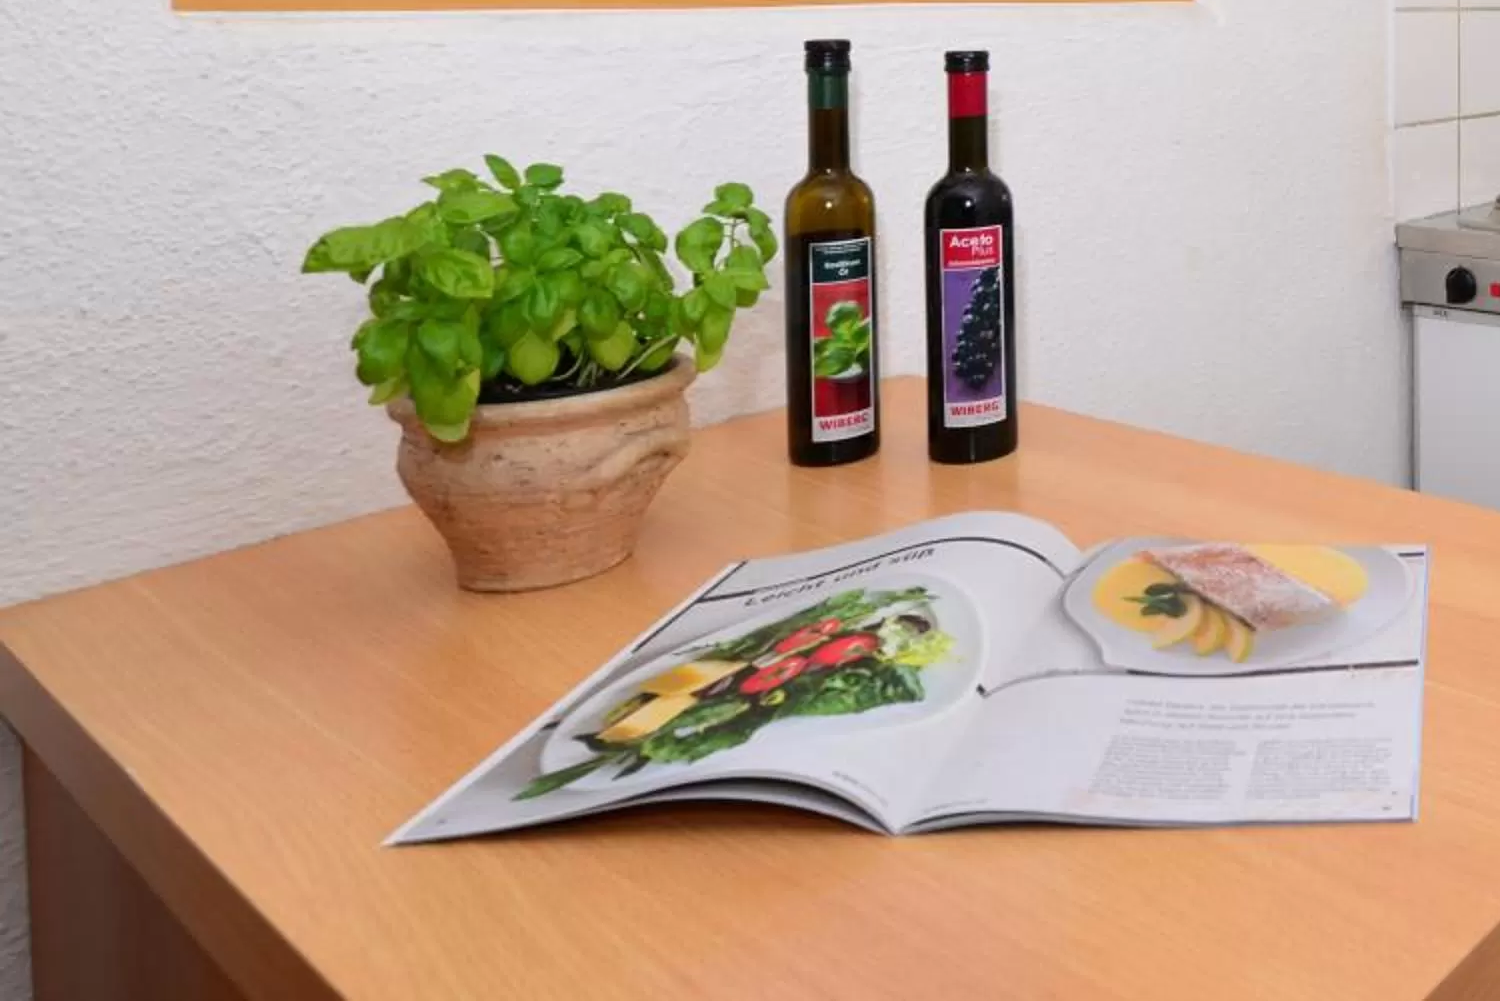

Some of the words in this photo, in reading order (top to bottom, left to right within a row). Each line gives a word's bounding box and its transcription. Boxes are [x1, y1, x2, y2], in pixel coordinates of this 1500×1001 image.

[949, 233, 993, 248] Aceto
[950, 400, 1000, 416] WIBERG
[819, 413, 868, 431] WIBERG
[744, 579, 827, 607] Leicht
[833, 561, 882, 583] und
